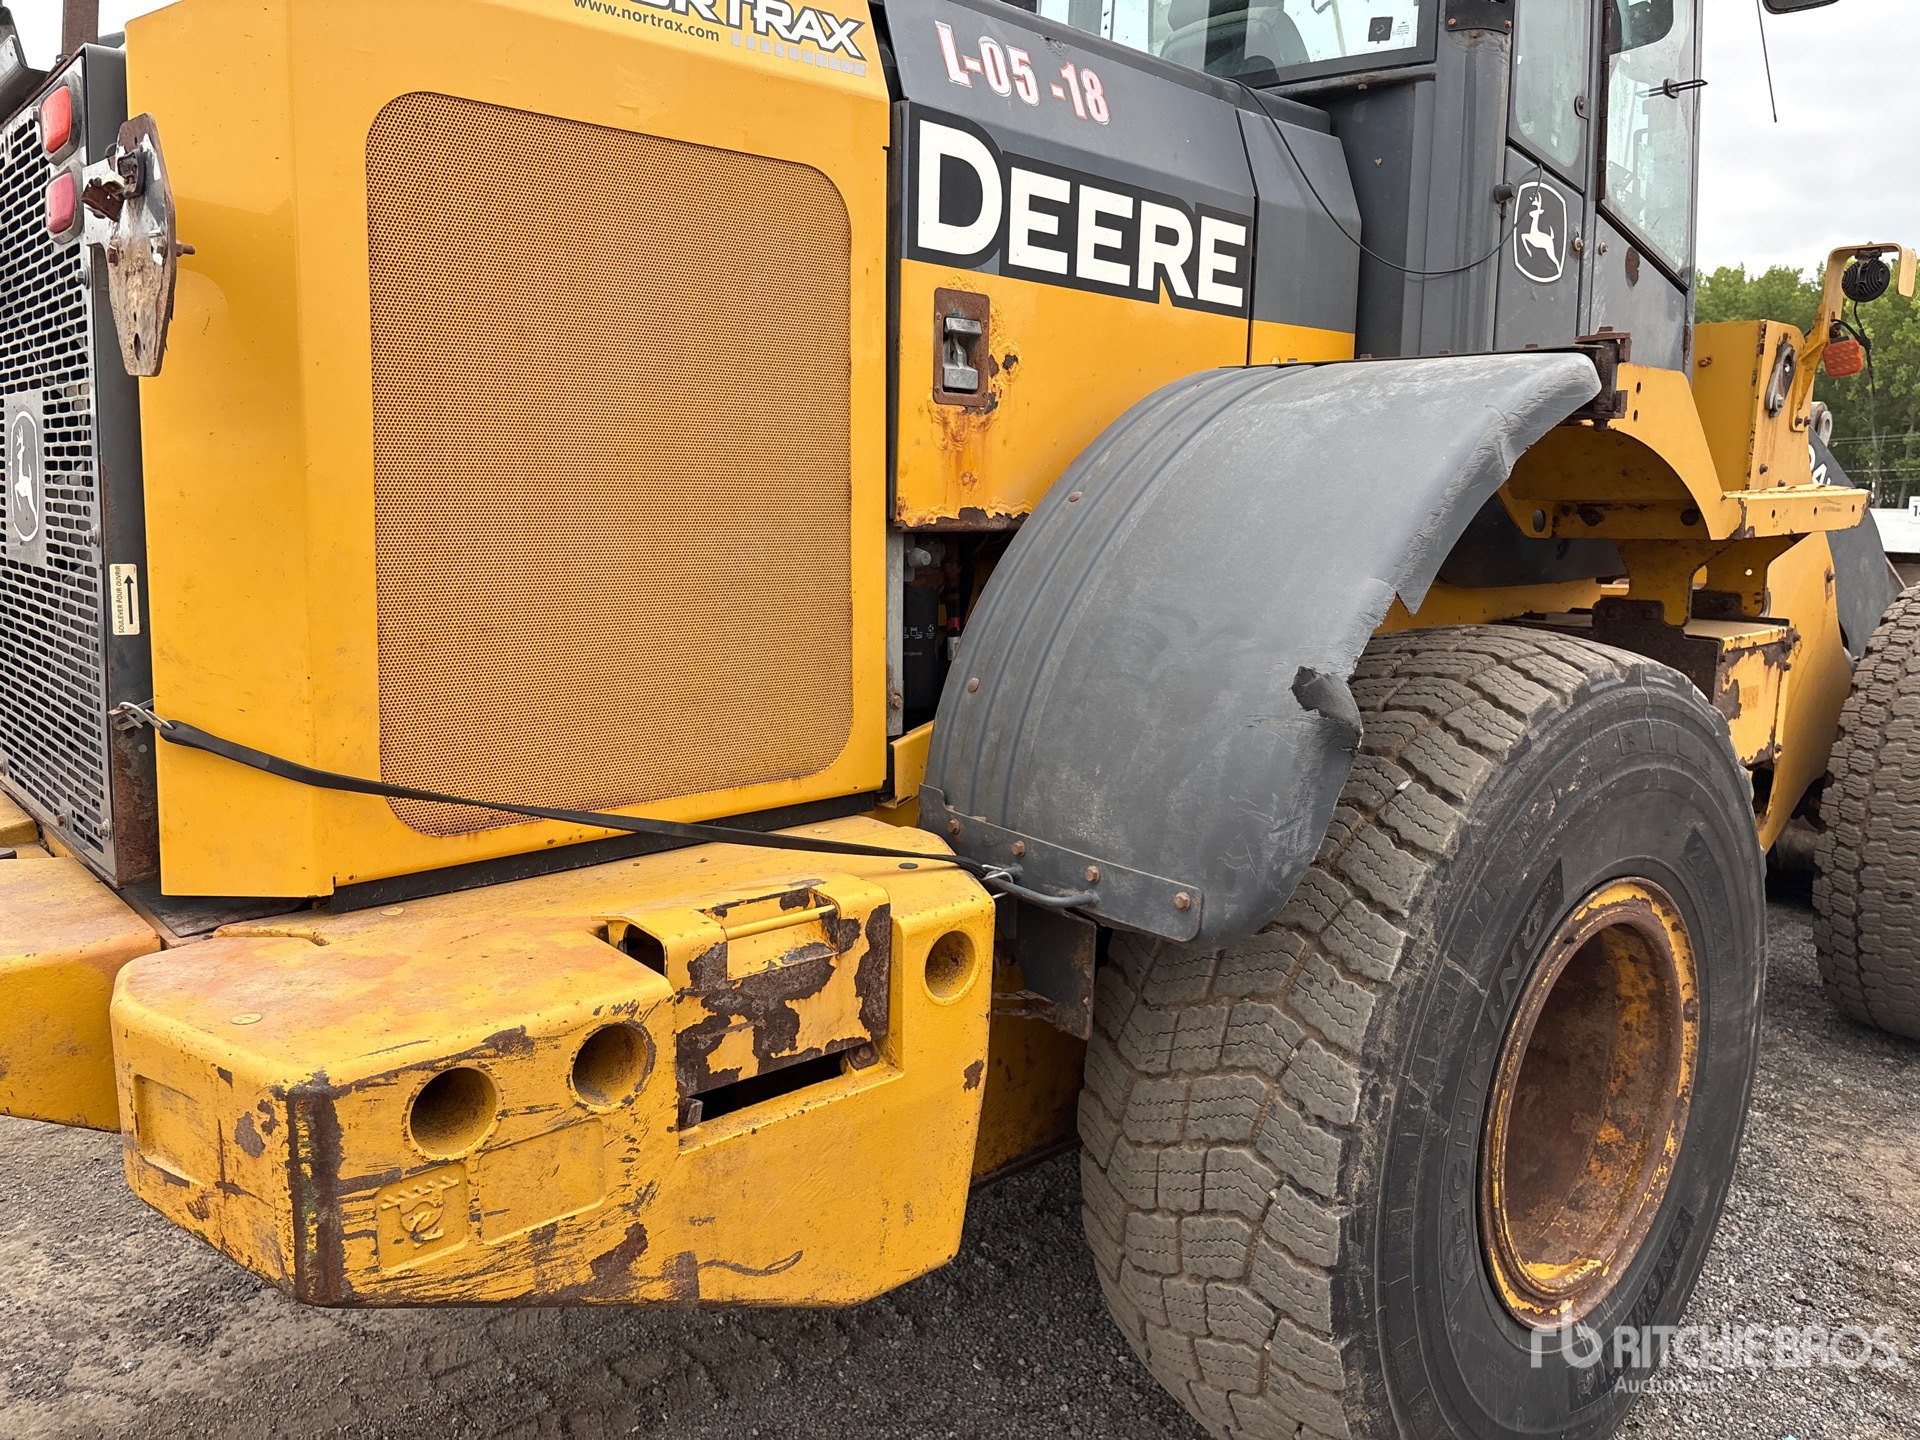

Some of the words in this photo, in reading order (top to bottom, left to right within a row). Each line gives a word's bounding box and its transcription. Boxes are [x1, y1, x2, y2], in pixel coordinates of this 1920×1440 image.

[573, 0, 720, 42] www.nortrax.com
[630, 0, 867, 61] TRAX
[934, 20, 1040, 106] L-05
[917, 119, 1247, 308] DEERE
[117, 605, 125, 633] SOULEVER
